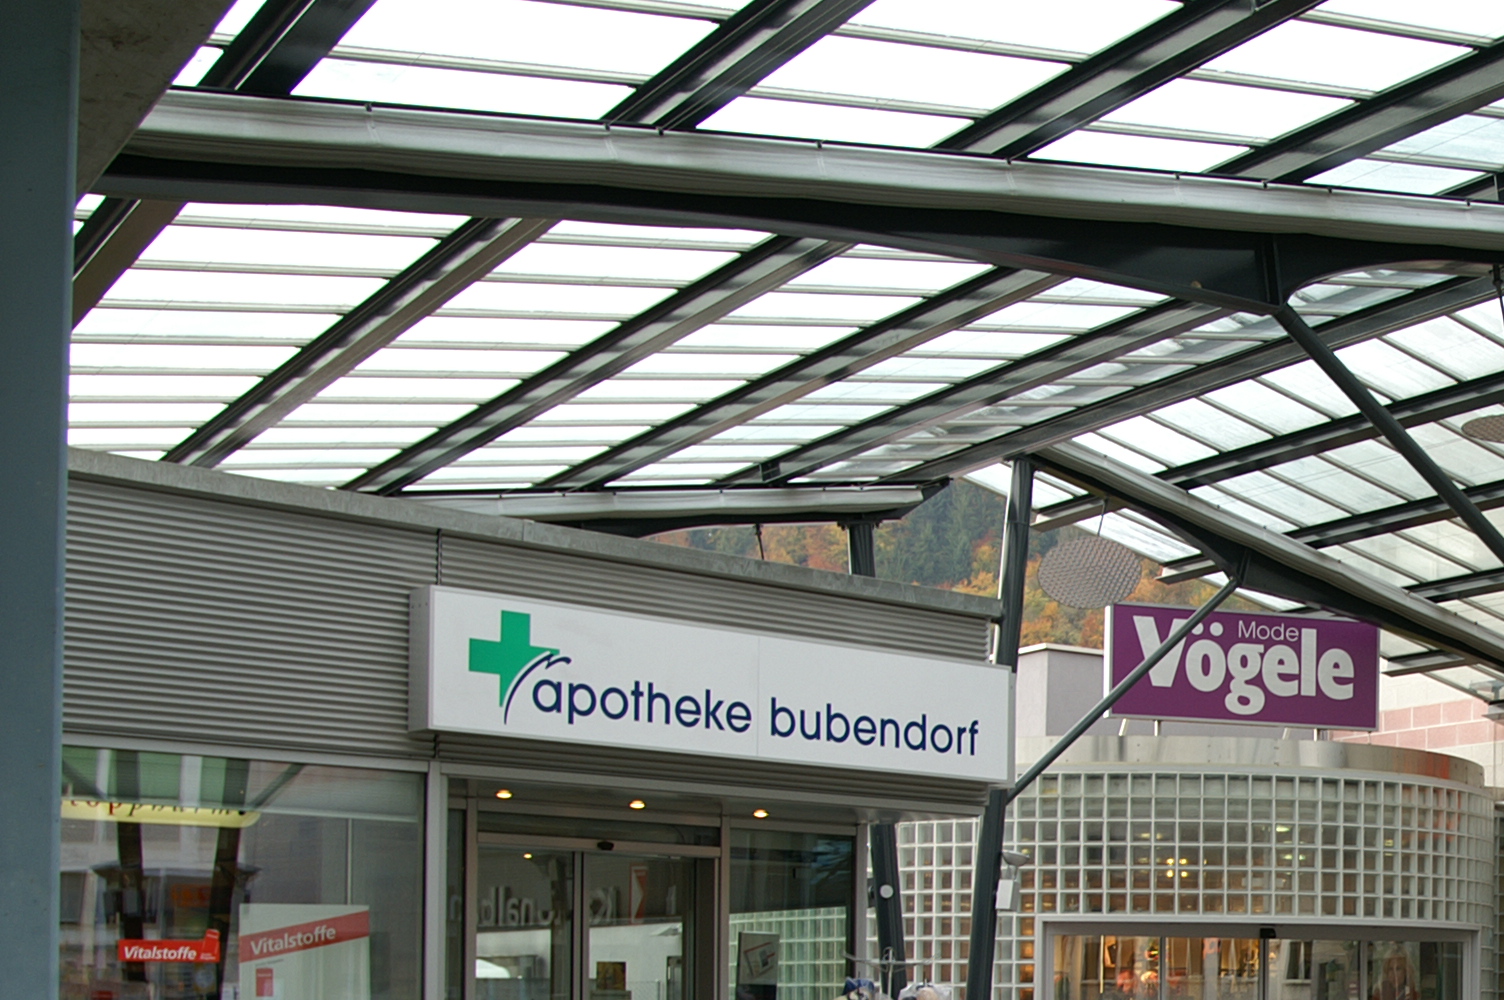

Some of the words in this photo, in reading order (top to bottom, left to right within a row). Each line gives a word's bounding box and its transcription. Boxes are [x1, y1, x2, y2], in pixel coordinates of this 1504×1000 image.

[1238, 620, 1299, 642] Mode
[1133, 615, 1355, 715] Vögele
[532, 680, 752, 733] apotheke
[770, 697, 979, 756] bubendorf
[123, 946, 197, 960] Vitalstoffe
[250, 925, 337, 955] Vitalstoffe
